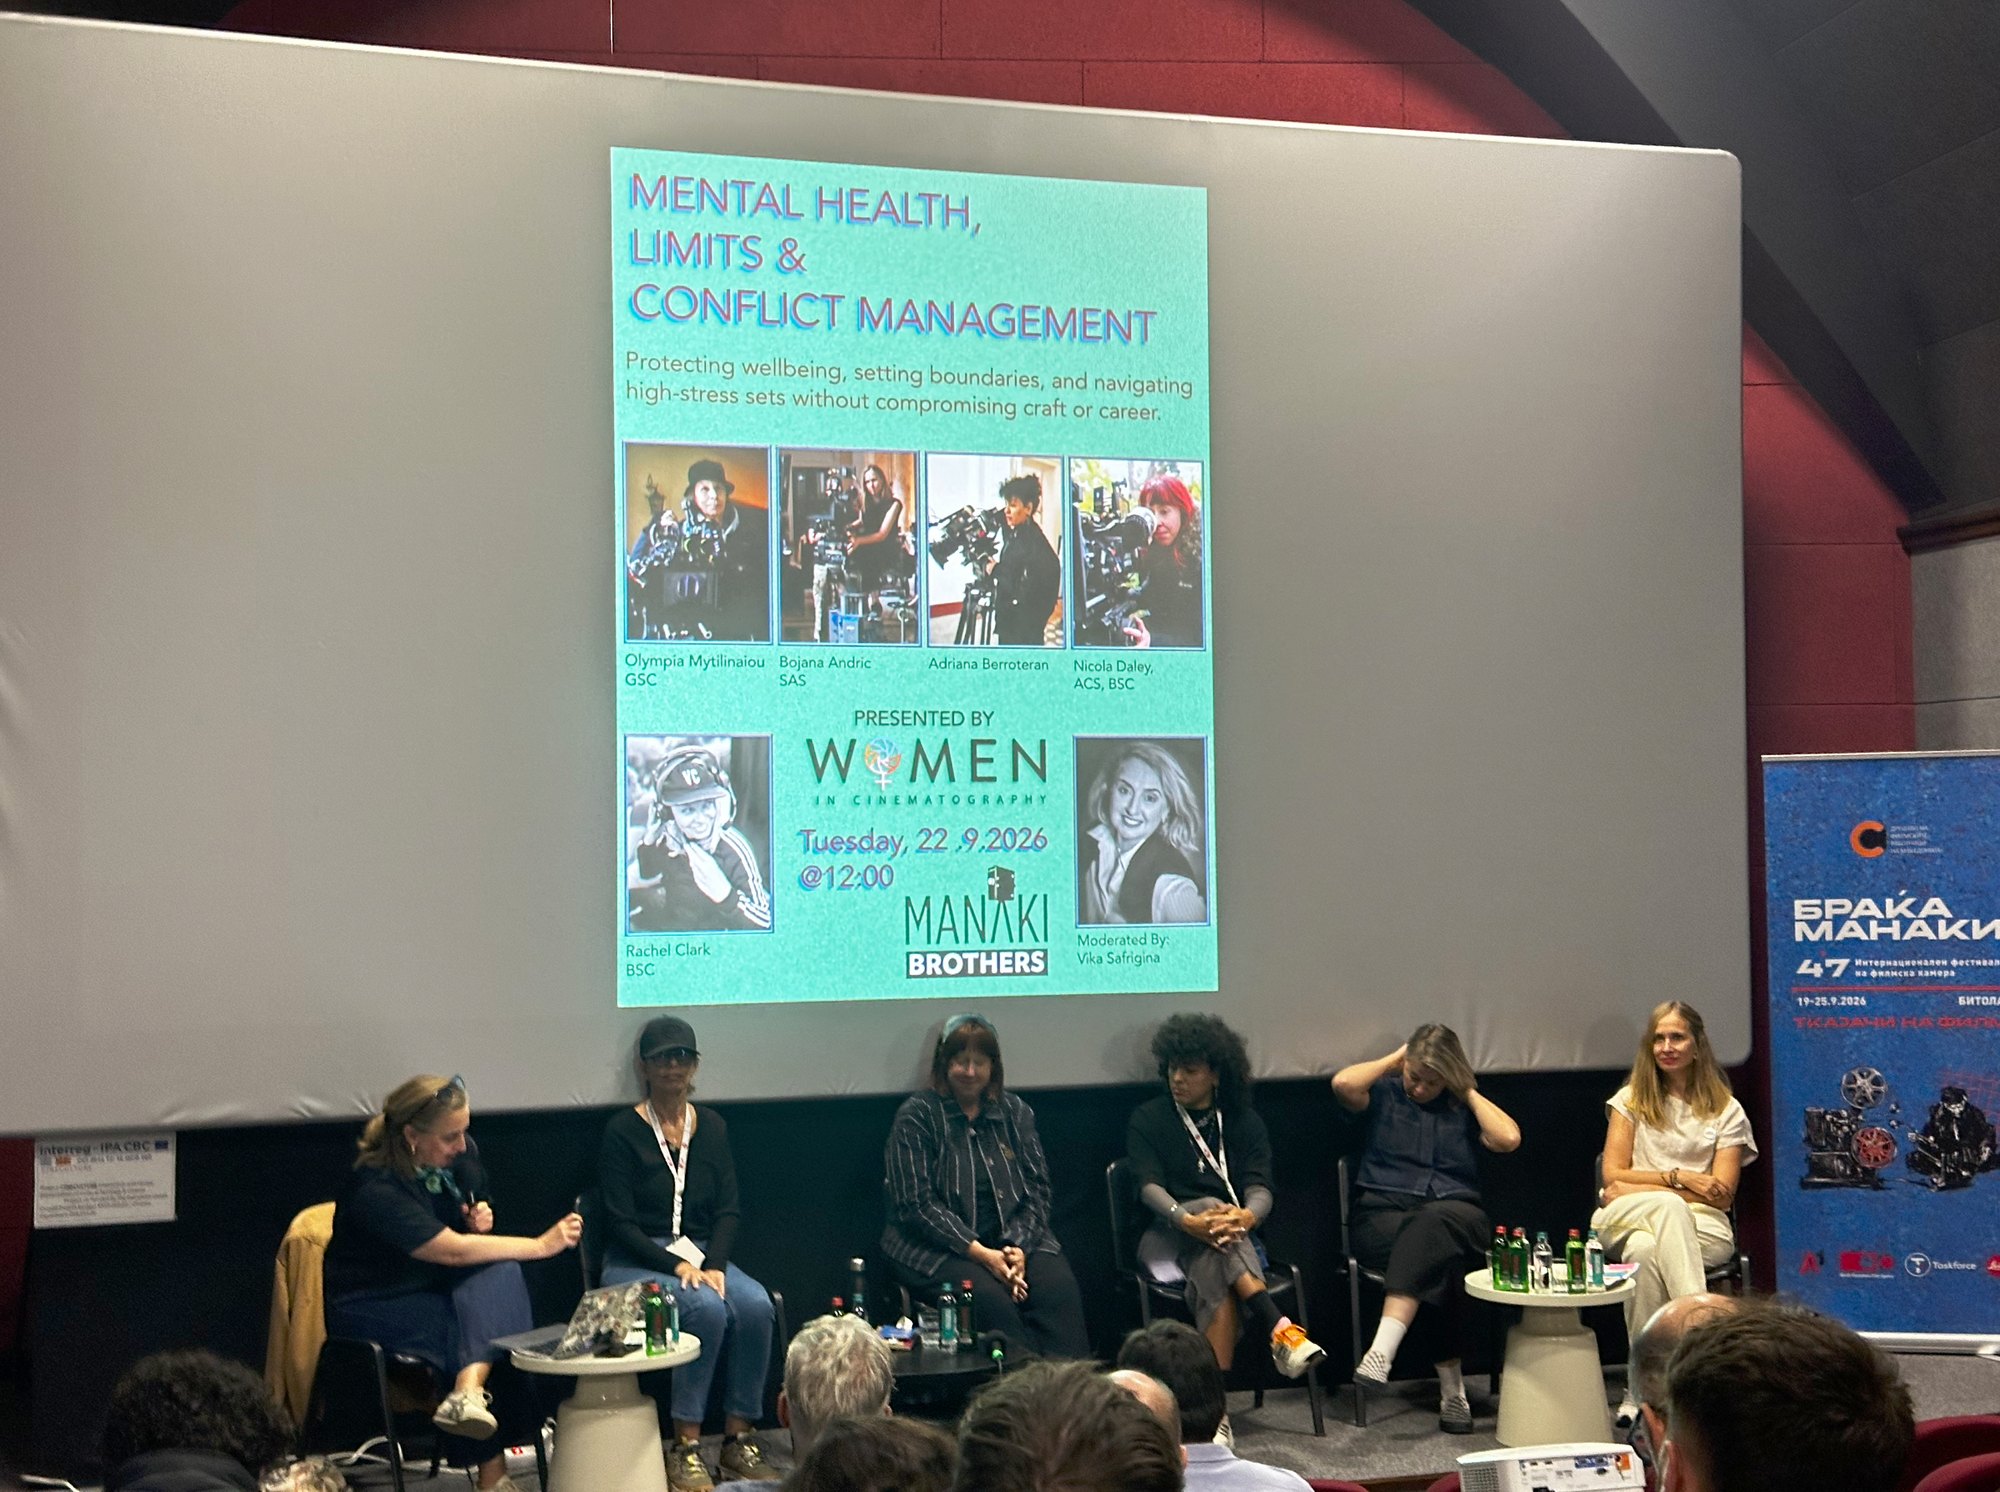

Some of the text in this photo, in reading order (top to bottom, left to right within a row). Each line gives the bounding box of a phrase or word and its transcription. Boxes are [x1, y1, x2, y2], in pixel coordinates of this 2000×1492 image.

[631, 173, 982, 238] MENTAL HEALTH,
[631, 228, 808, 273] LIMITS &
[630, 284, 1158, 344] CONFLICT MANAGEMENT
[626, 351, 1193, 400] Protecting wellbeing, setting boundaries, and navigating
[626, 380, 1161, 421] high-stress sets without compromising craft or career.
[625, 653, 765, 672] Olympia Mytilinaiou
[779, 656, 872, 672] Bojana Andric
[928, 657, 1049, 671] Adriana Berroteran
[1074, 659, 1154, 676] Nicola Daley,
[625, 673, 657, 686] GSC
[779, 674, 807, 687] SAS
[1074, 678, 1135, 691] ACS, BSC
[854, 710, 994, 726] PRESENTED BY
[815, 794, 1047, 806] IN CINEMATOGRAPHY
[799, 827, 909, 859] Tuesday,
[917, 828, 948, 851] 22
[800, 864, 895, 889] @12:00
[1794, 889, 1954, 921] БРАЌА
[904, 893, 1049, 945] MANAKI
[1794, 919, 2000, 942] МАНАКИ
[1077, 932, 1170, 949] Moderated By:
[626, 942, 711, 957] Rachel Clark
[908, 950, 1046, 976] BROTHERS
[1077, 951, 1161, 967] Vika Safrigina
[1796, 958, 1850, 978] 47
[1855, 957, 1949, 968] Интернационален
[626, 963, 655, 977] BSC
[1870, 968, 1915, 979] филмска
[1918, 968, 1956, 979] камера
[1798, 996, 1867, 1007] 19-25.9.2026
